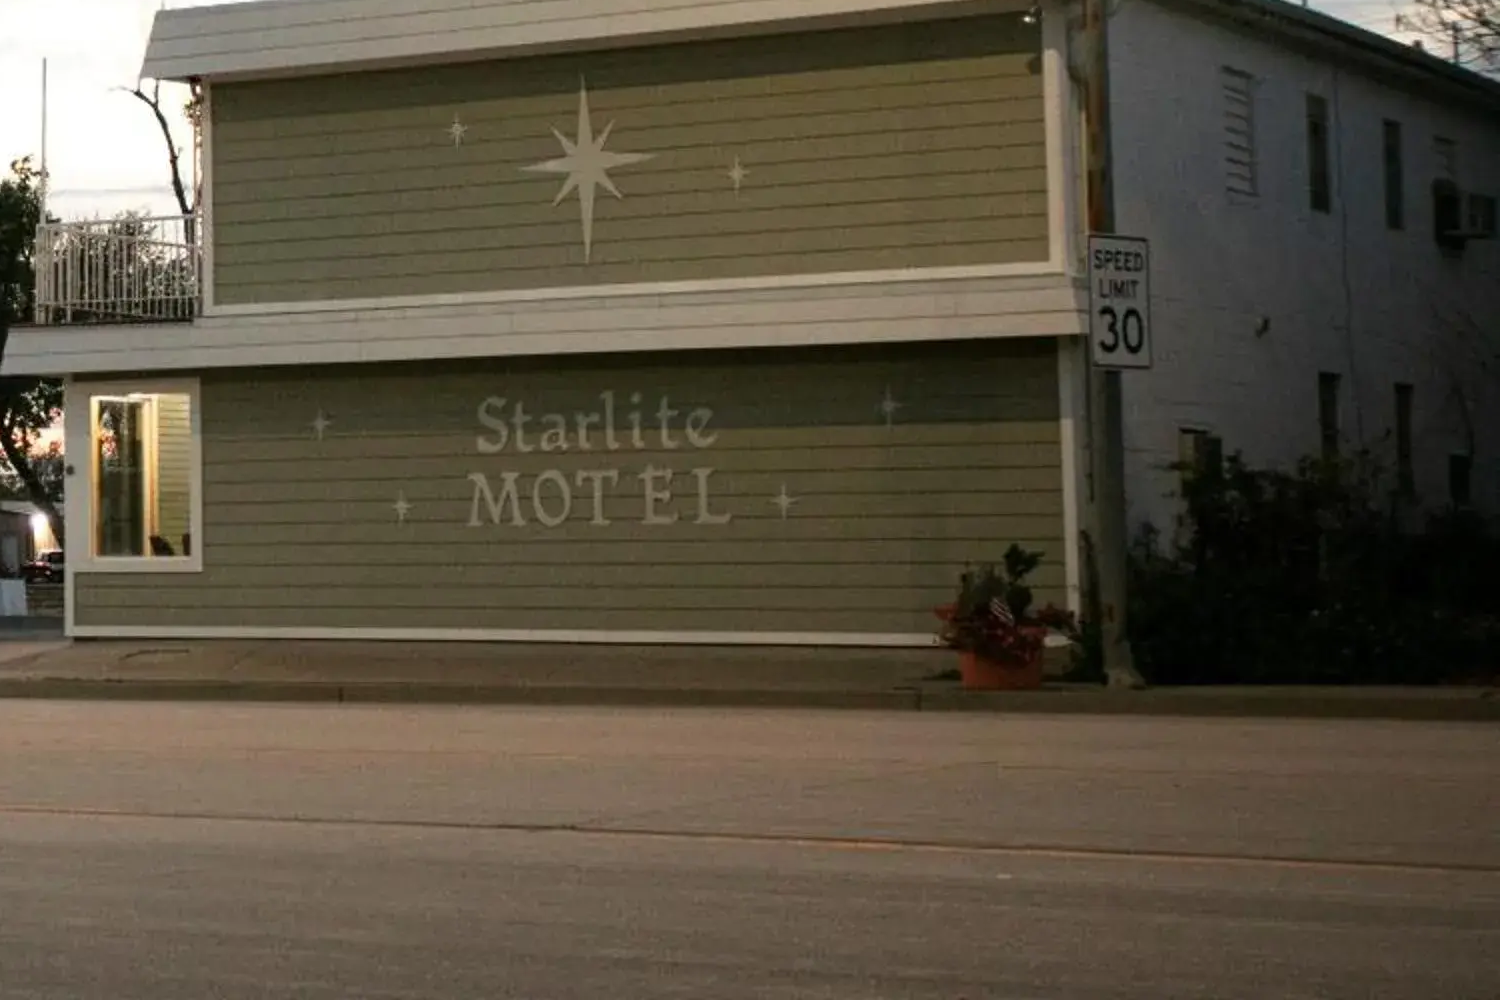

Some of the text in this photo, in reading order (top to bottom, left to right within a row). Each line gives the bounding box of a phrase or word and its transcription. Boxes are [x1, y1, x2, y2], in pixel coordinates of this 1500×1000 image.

[1094, 249, 1143, 272] SPEED
[1099, 279, 1139, 298] LIMIT
[1098, 305, 1144, 354] 30
[476, 390, 718, 453] Starlite
[466, 463, 732, 527] MOTEL
